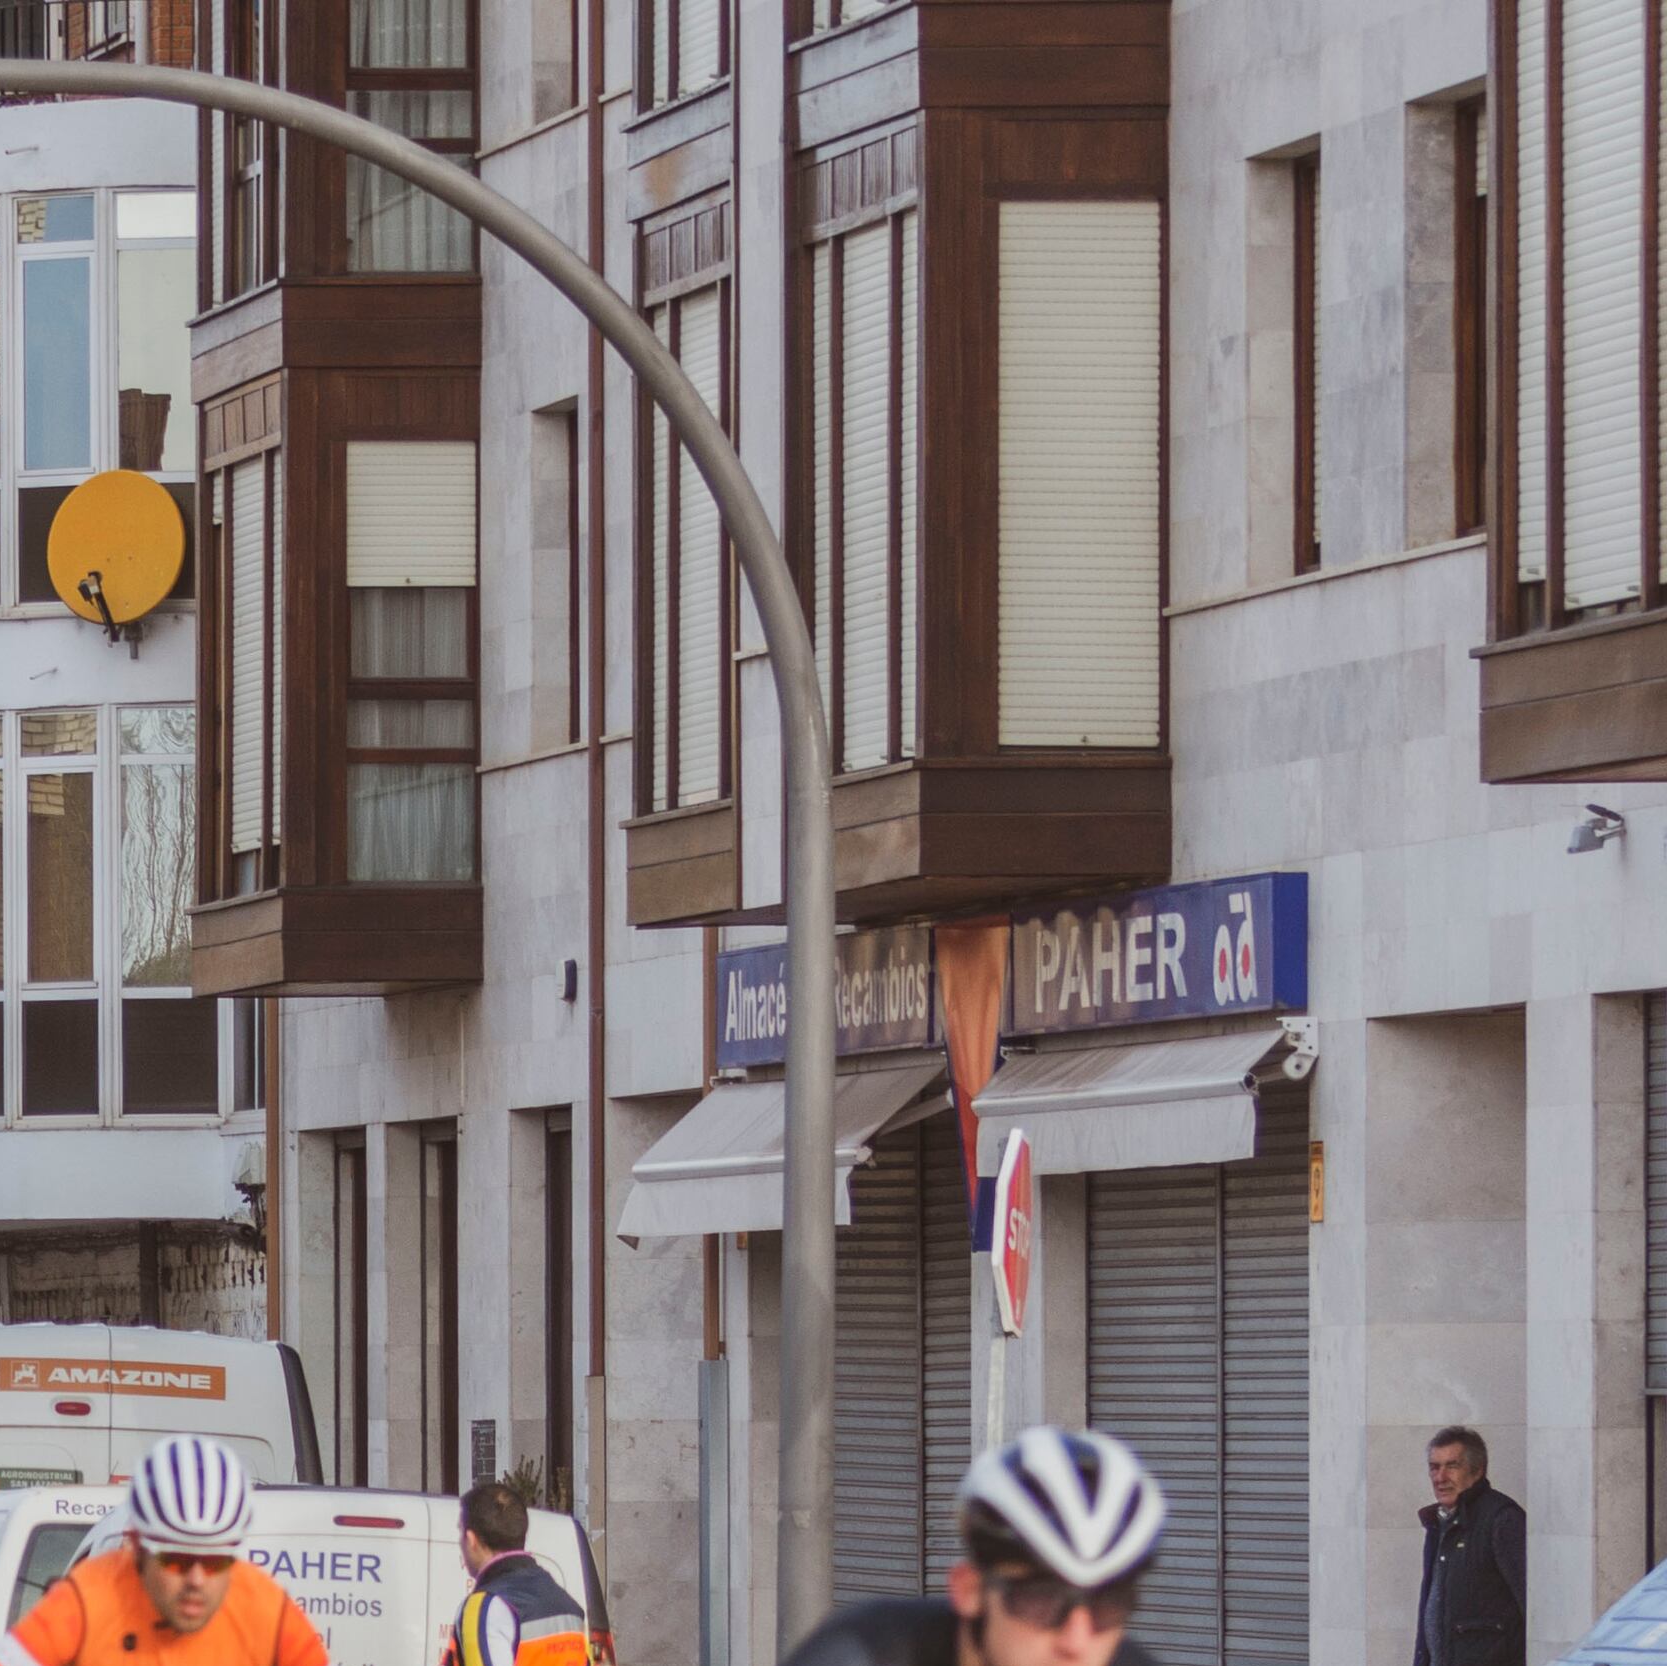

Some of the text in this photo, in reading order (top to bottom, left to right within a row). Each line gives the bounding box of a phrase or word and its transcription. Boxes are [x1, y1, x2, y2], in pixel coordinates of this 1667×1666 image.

[1035, 912, 1188, 1013] PAHER
[725, 962, 787, 1042] Almacé
[48, 1367, 211, 1390] AMAZONE
[0, 1470, 74, 1481] AGROINDUSTRIAL
[248, 1550, 382, 1583] PAHER
[295, 1592, 383, 1617] ambios
